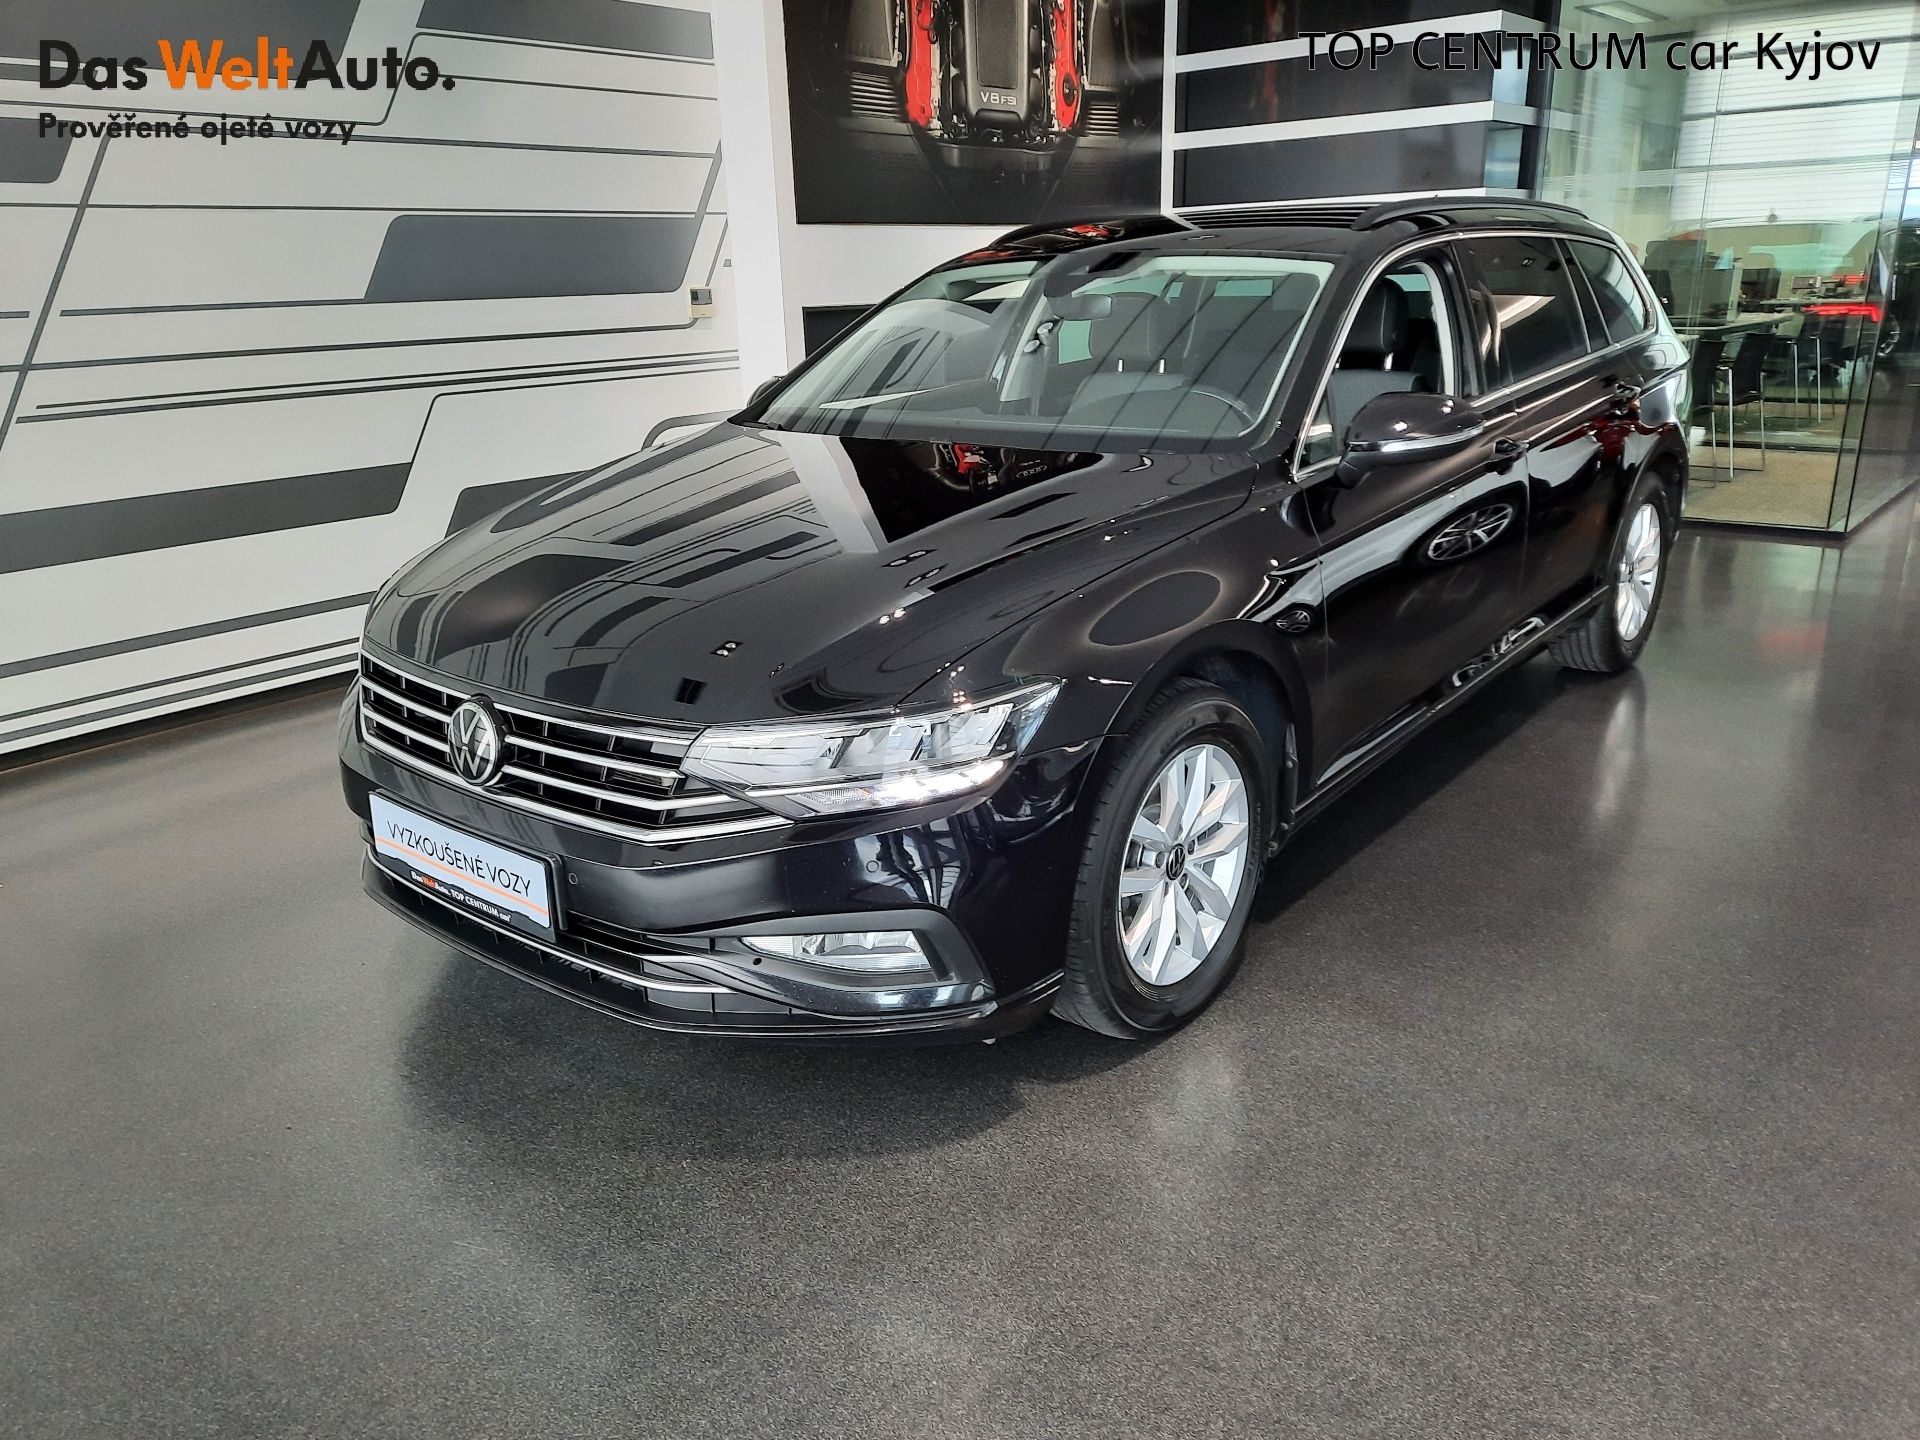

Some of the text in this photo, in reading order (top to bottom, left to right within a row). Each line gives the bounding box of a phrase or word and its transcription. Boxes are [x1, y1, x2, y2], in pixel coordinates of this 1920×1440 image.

[980, 91, 1017, 106] V8 FSI
[387, 820, 532, 898] VYZKOUŠENÉ VOZY
[450, 889, 465, 902] TOP
[465, 895, 500, 918] CENTRUM
